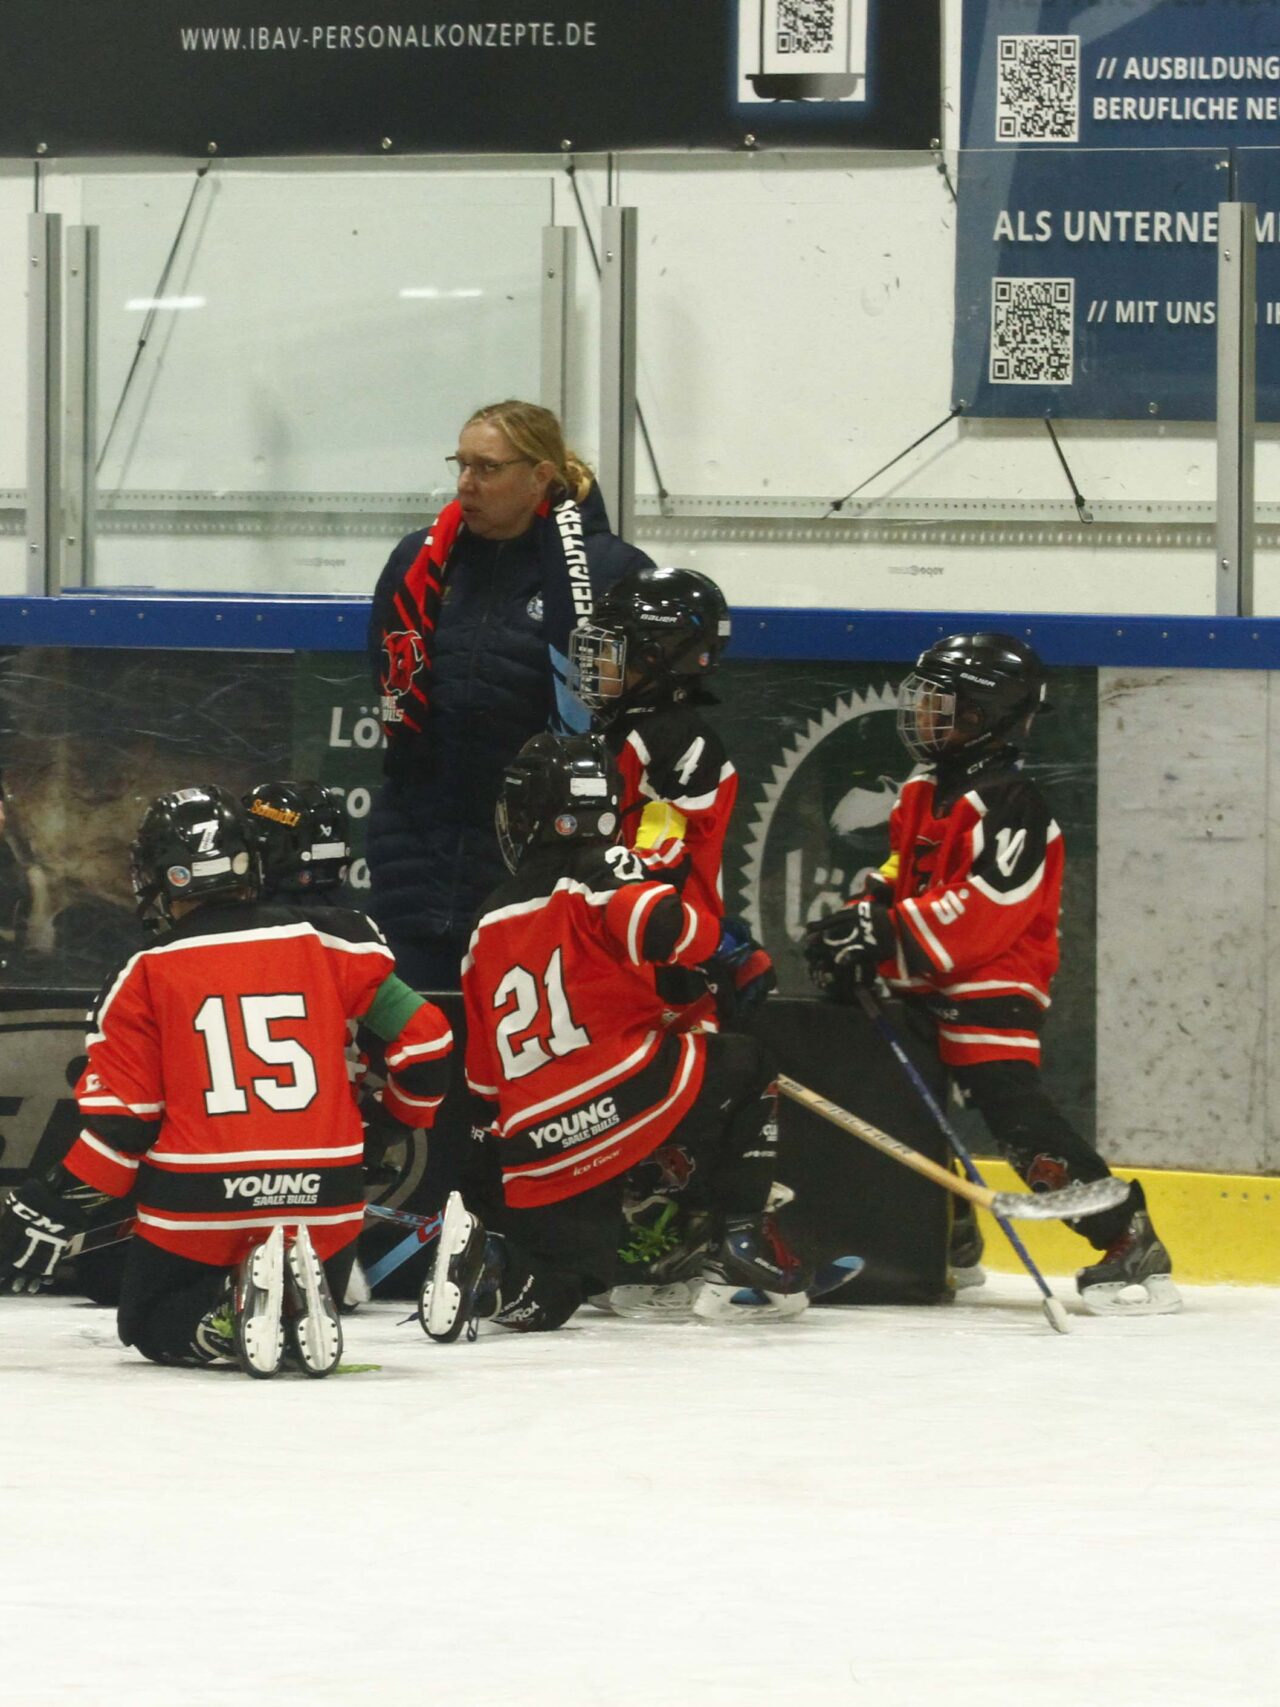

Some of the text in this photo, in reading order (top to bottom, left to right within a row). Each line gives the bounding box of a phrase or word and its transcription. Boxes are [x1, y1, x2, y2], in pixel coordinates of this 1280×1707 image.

[180, 22, 597, 51] WWW.IBAV-PERSONALKONZEPTE.DE
[1093, 96, 1280, 120] BERUFLICHE NE
[992, 211, 1052, 242] ALS
[1116, 302, 1159, 323] MIT
[493, 945, 592, 1081] 21
[193, 992, 318, 1115] 15
[528, 1096, 617, 1149] YOUNG
[589, 1113, 621, 1135] BULLS
[222, 1172, 322, 1199] YOUNG
[252, 1194, 318, 1207] SAALE BULLS
